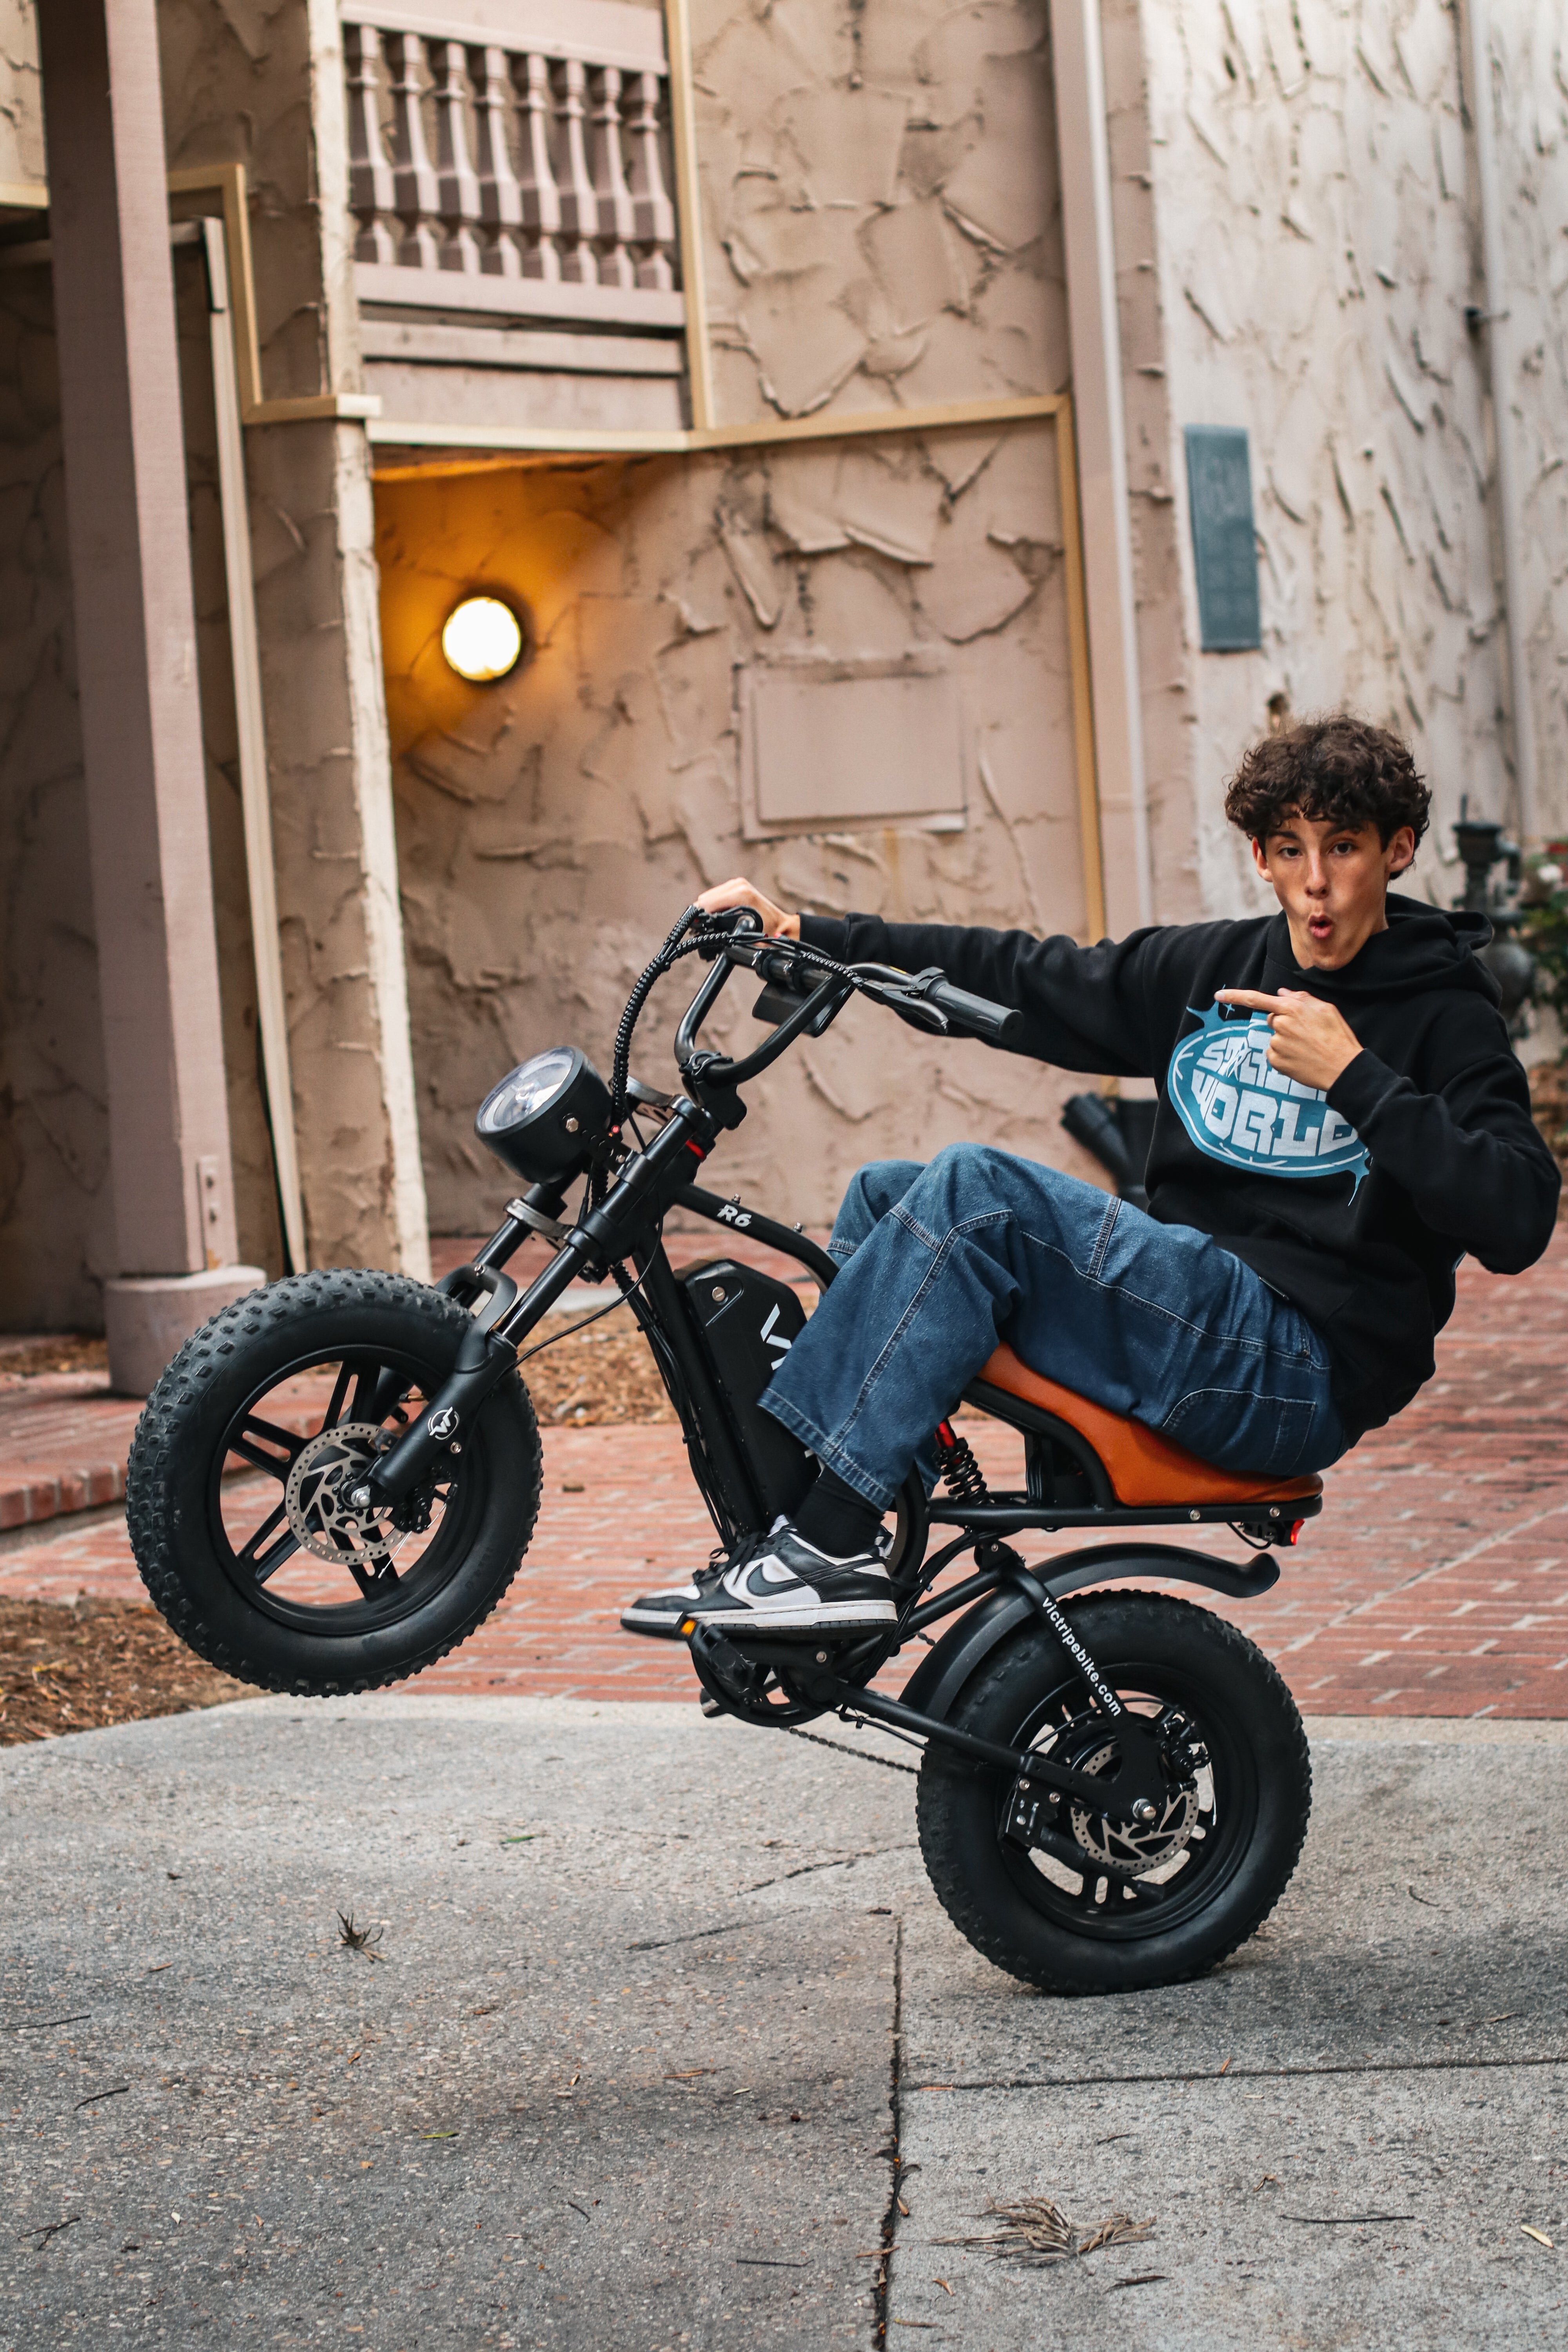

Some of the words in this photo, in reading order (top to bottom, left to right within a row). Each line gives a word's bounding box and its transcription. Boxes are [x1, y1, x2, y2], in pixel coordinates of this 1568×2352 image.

[1191, 1069, 1358, 1157] WORLD
[717, 1204, 752, 1227] R6
[1042, 1596, 1122, 1717] victripebike.com
